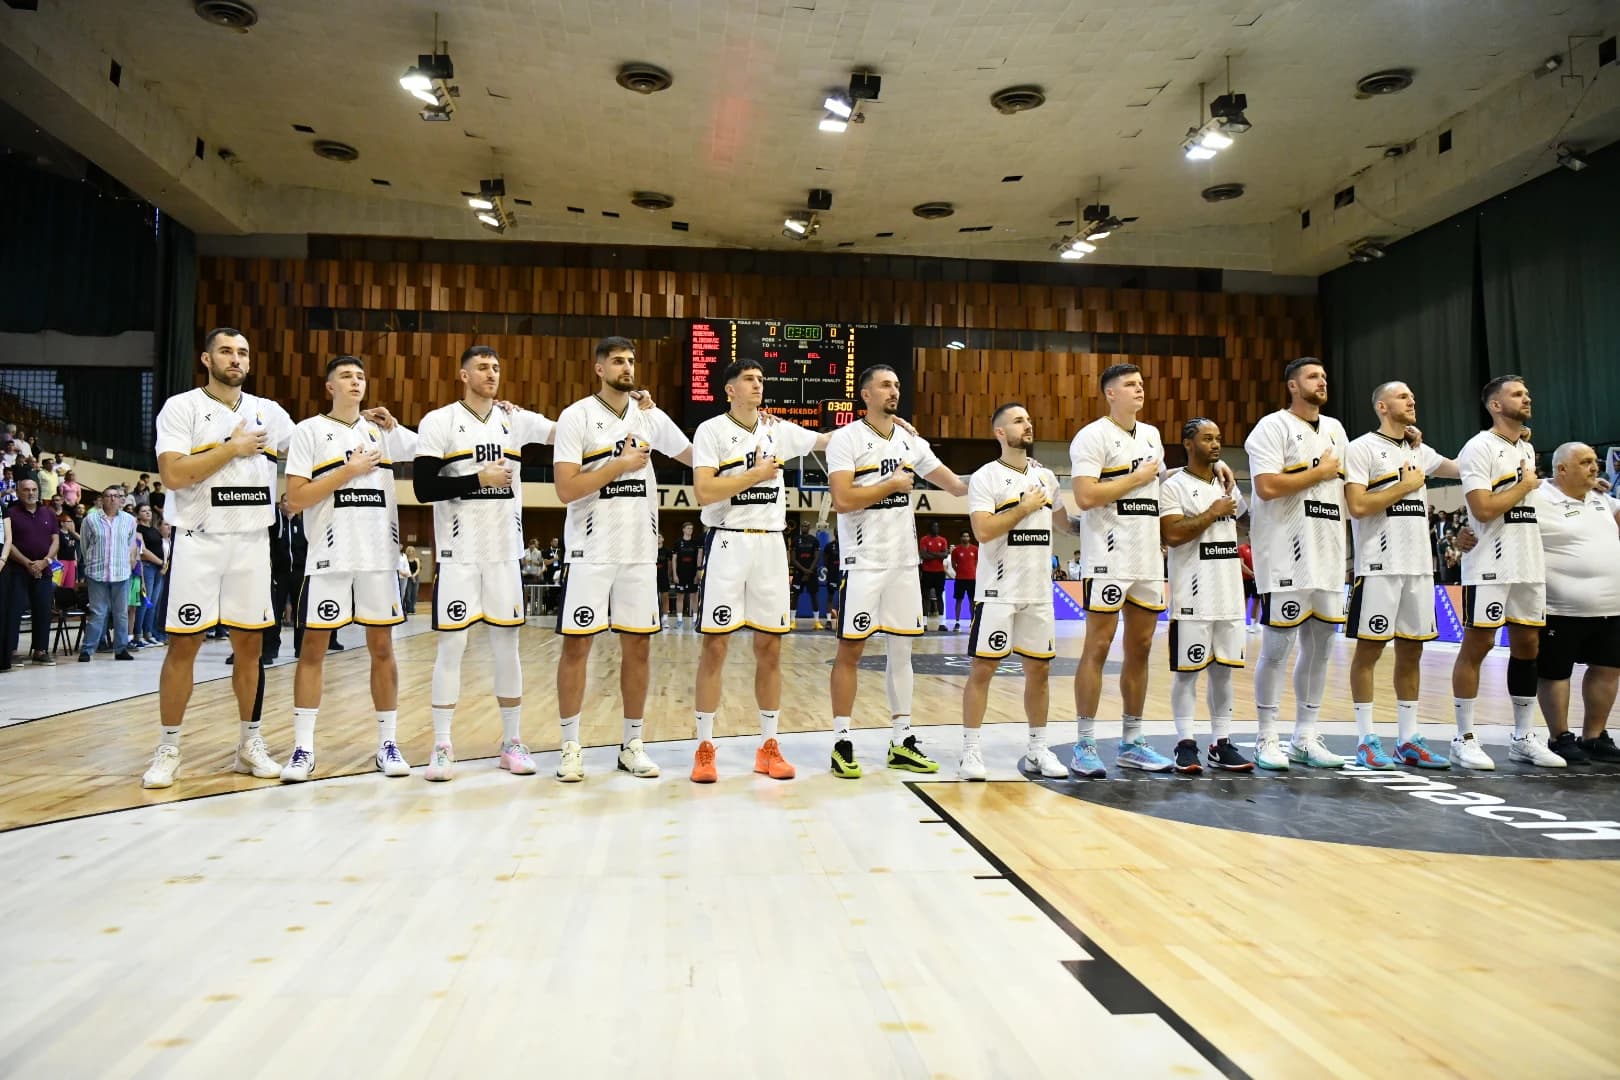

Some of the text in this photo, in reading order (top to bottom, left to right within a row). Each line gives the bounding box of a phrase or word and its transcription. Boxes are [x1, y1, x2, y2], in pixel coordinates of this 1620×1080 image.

[770, 327, 776, 336] 0
[787, 326, 820, 338] 03:00
[830, 328, 837, 337] 0
[828, 402, 852, 411] 03:00
[475, 443, 502, 462] BIH
[218, 490, 267, 501] telemach
